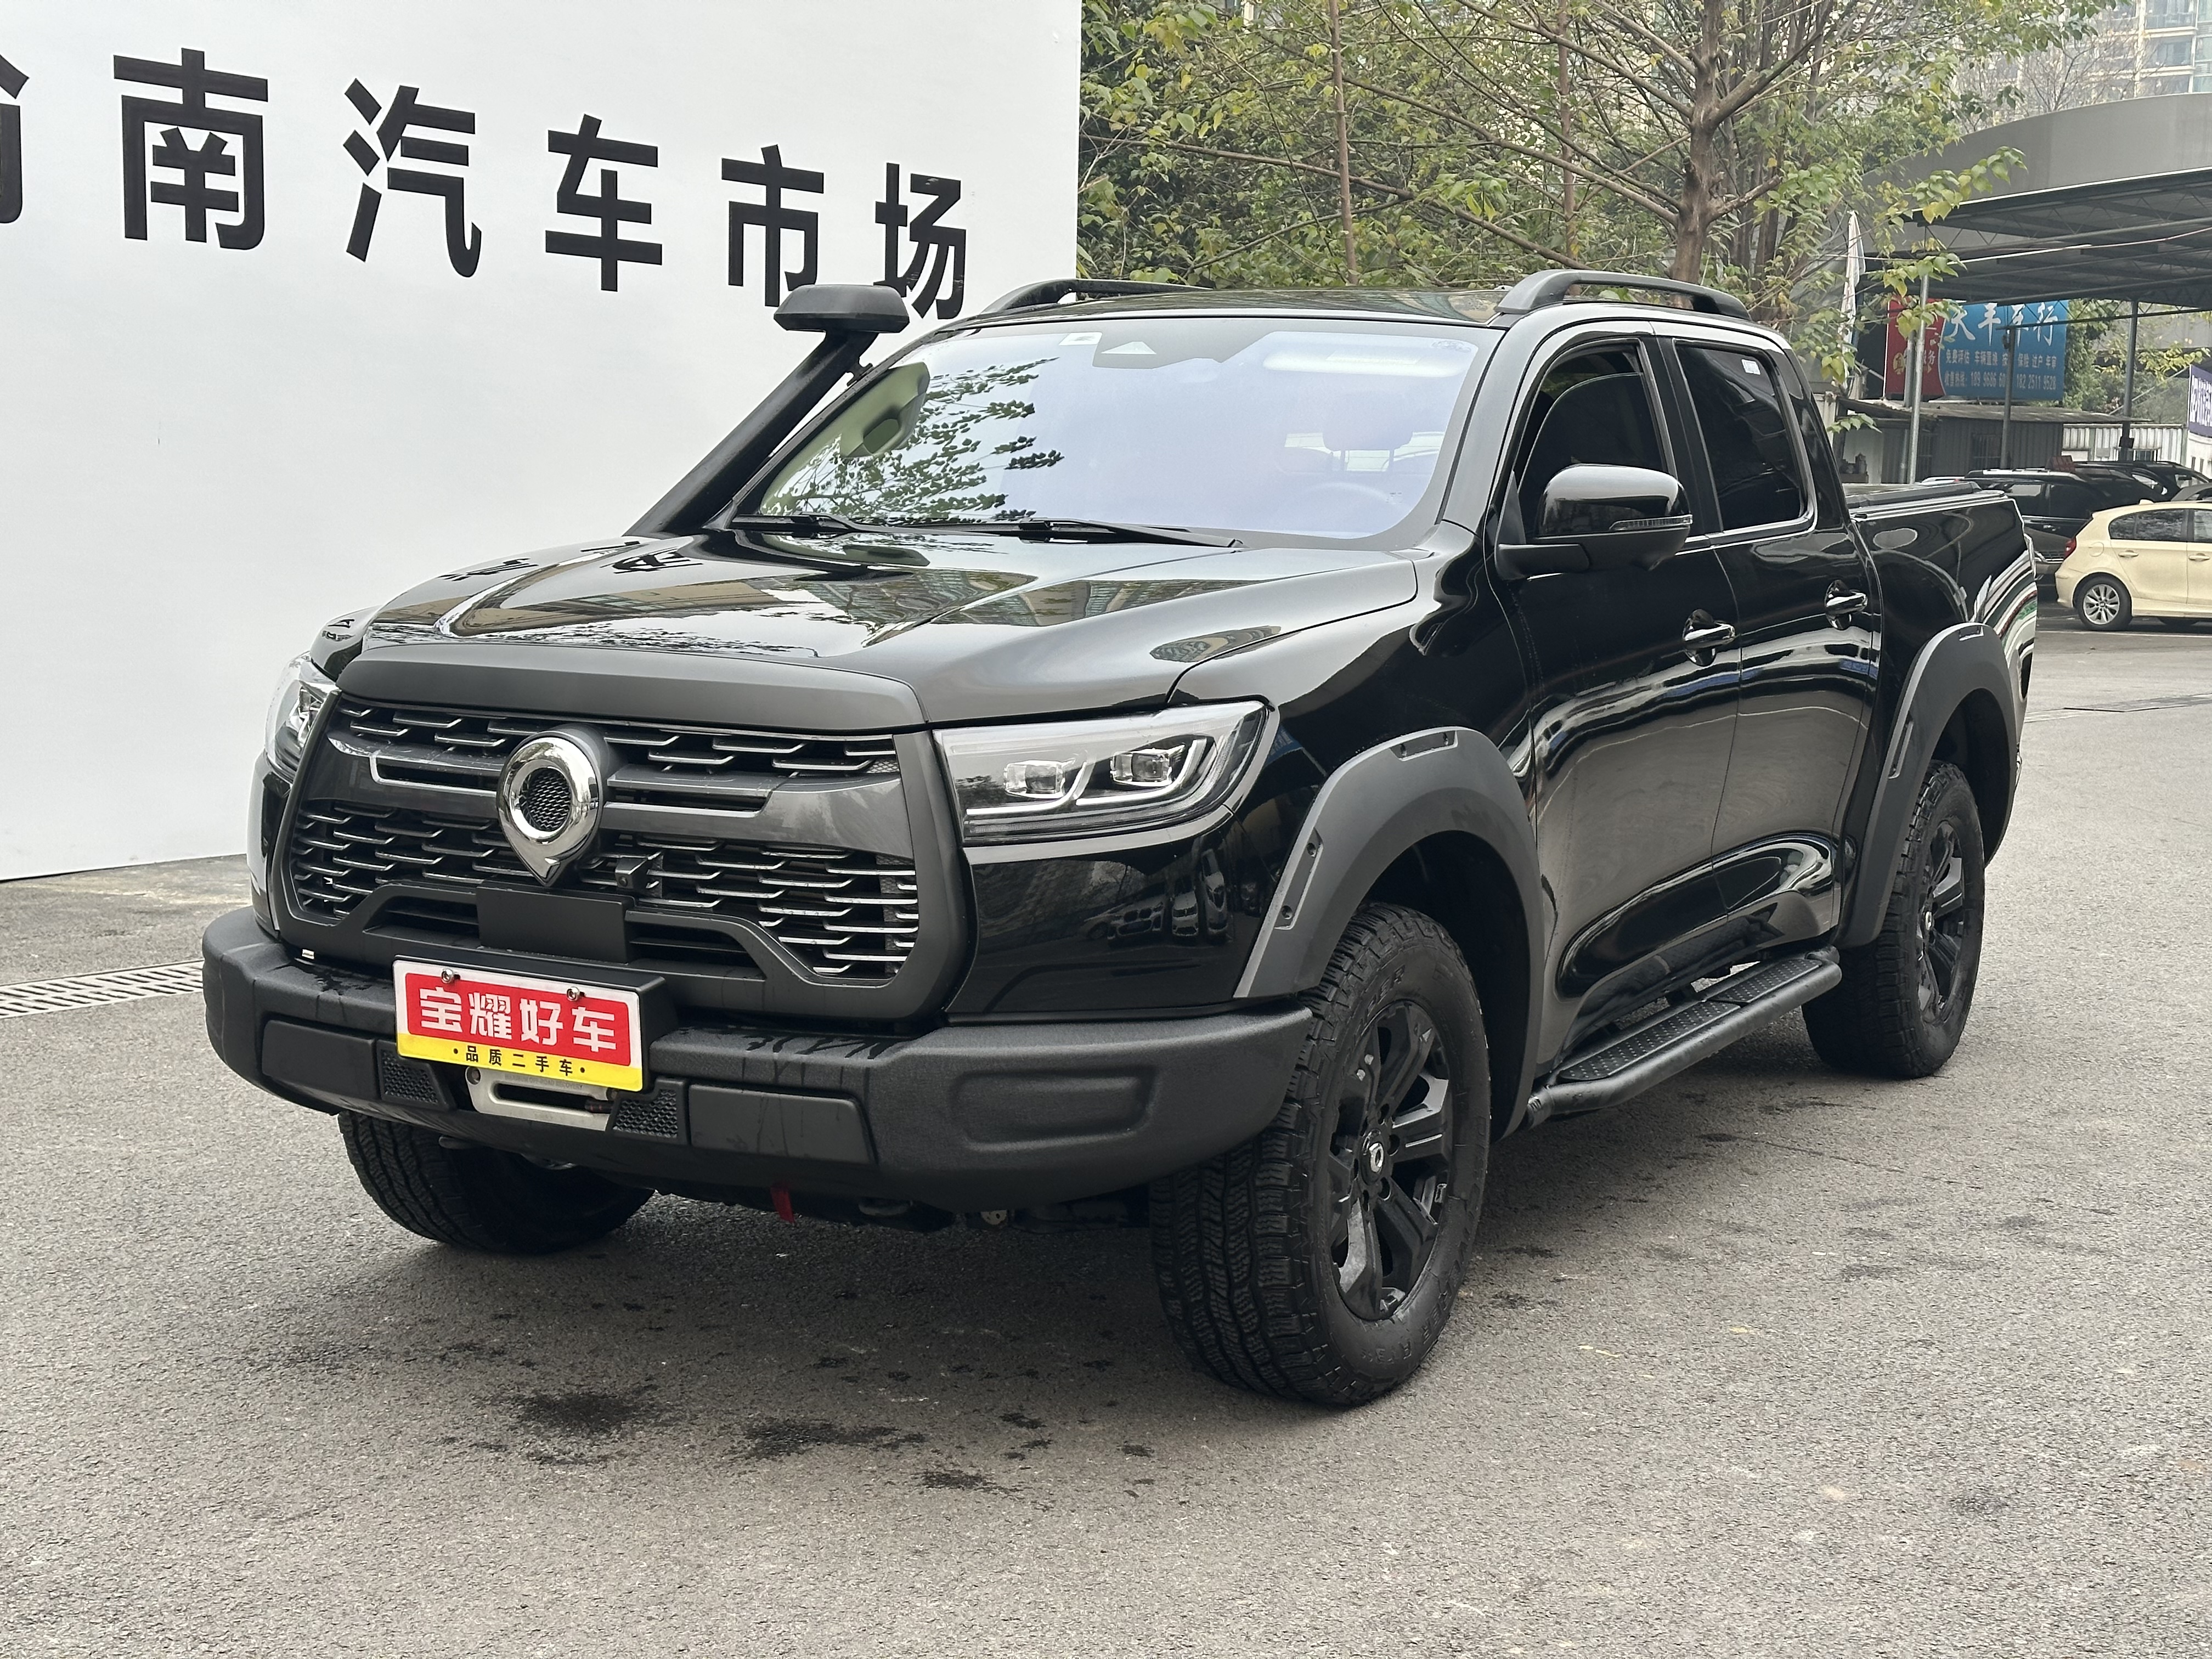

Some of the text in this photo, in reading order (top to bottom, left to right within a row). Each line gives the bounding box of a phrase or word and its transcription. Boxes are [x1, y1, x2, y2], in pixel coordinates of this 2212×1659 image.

[0, 47, 967, 320] 南汽车市场
[2032, 354, 2043, 368] 过户
[2017, 374, 2026, 388] 182
[419, 986, 617, 1052] 宝耀好车
[466, 1045, 573, 1076] 品质二手车
